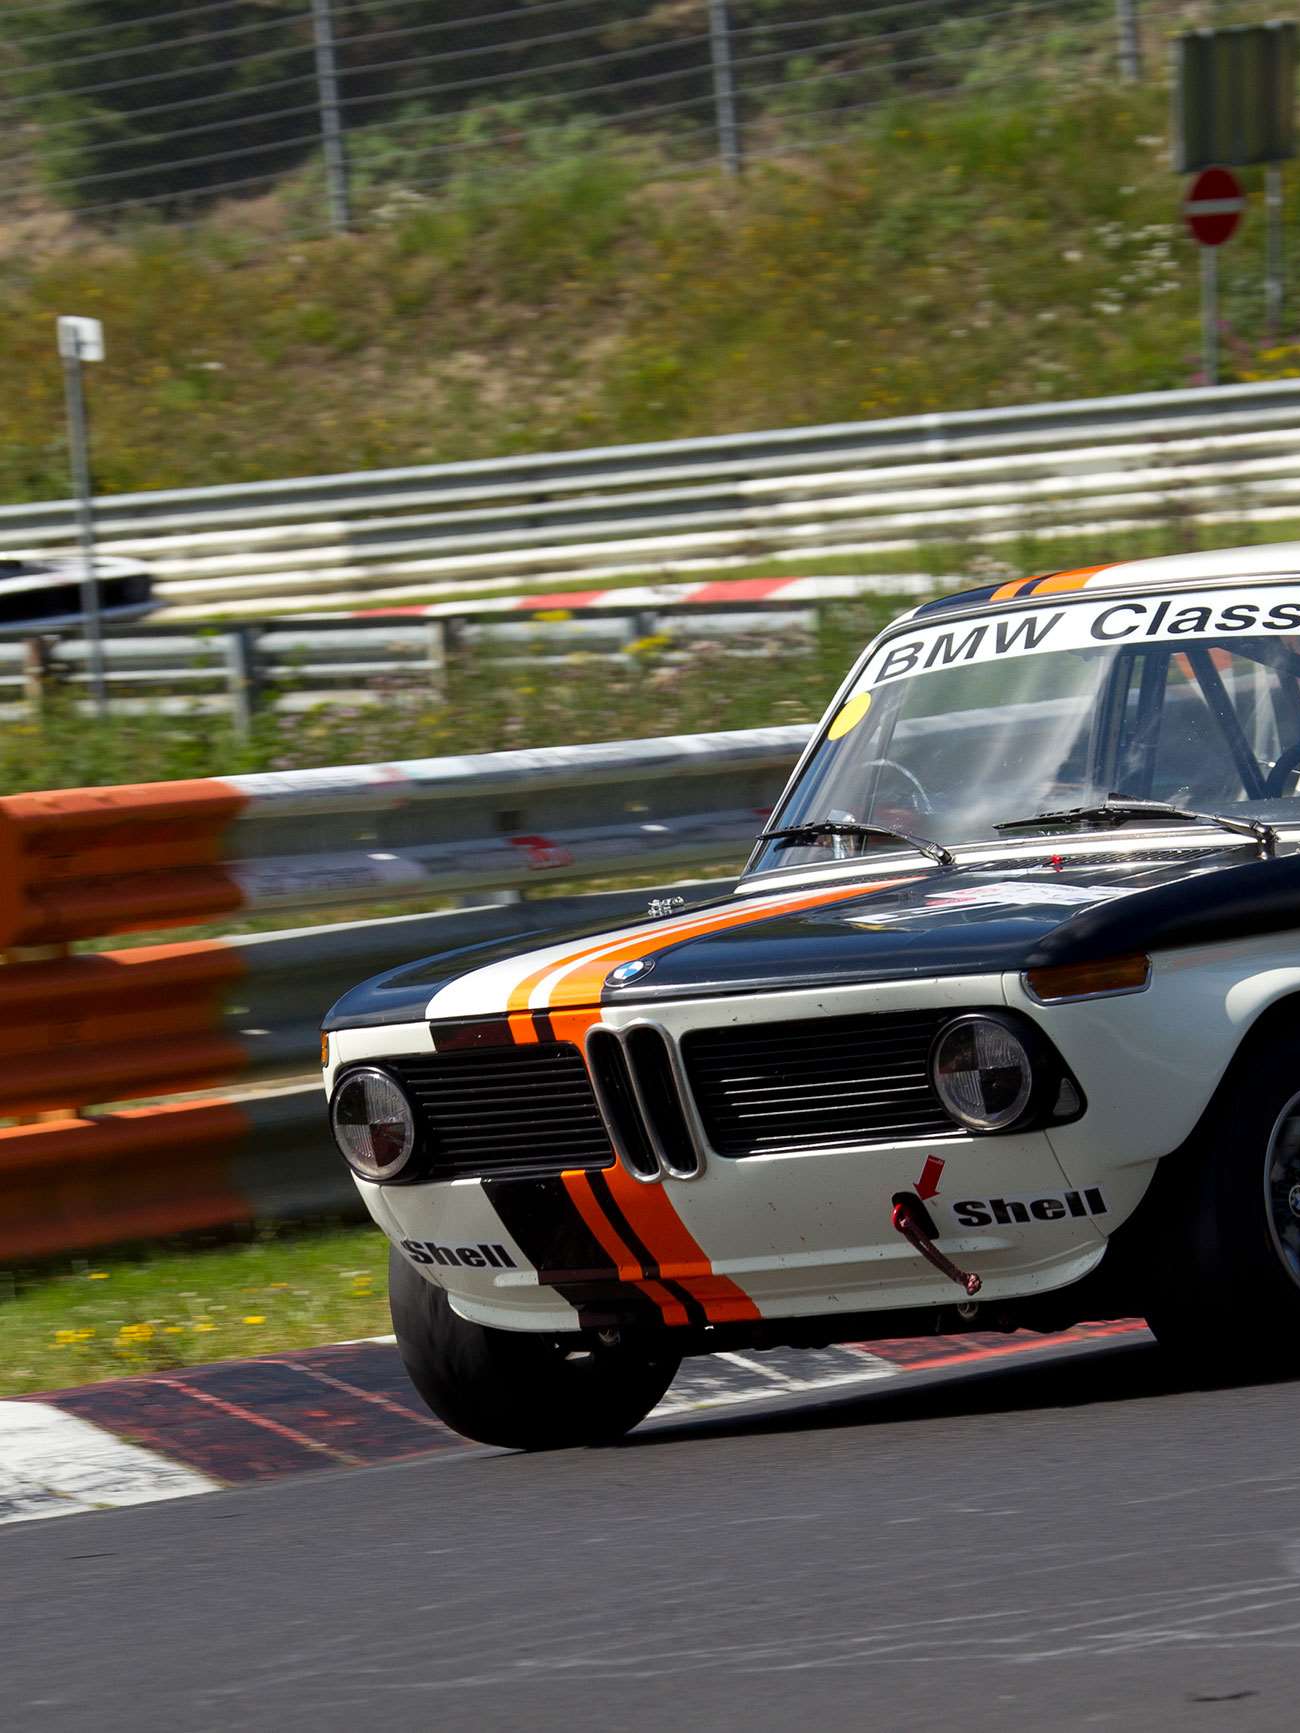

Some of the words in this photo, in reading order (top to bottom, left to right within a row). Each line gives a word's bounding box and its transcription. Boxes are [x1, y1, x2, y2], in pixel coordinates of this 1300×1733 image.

[874, 613, 1066, 682] BMW
[953, 1187, 1108, 1227] Shell
[405, 1239, 518, 1269] Shell
